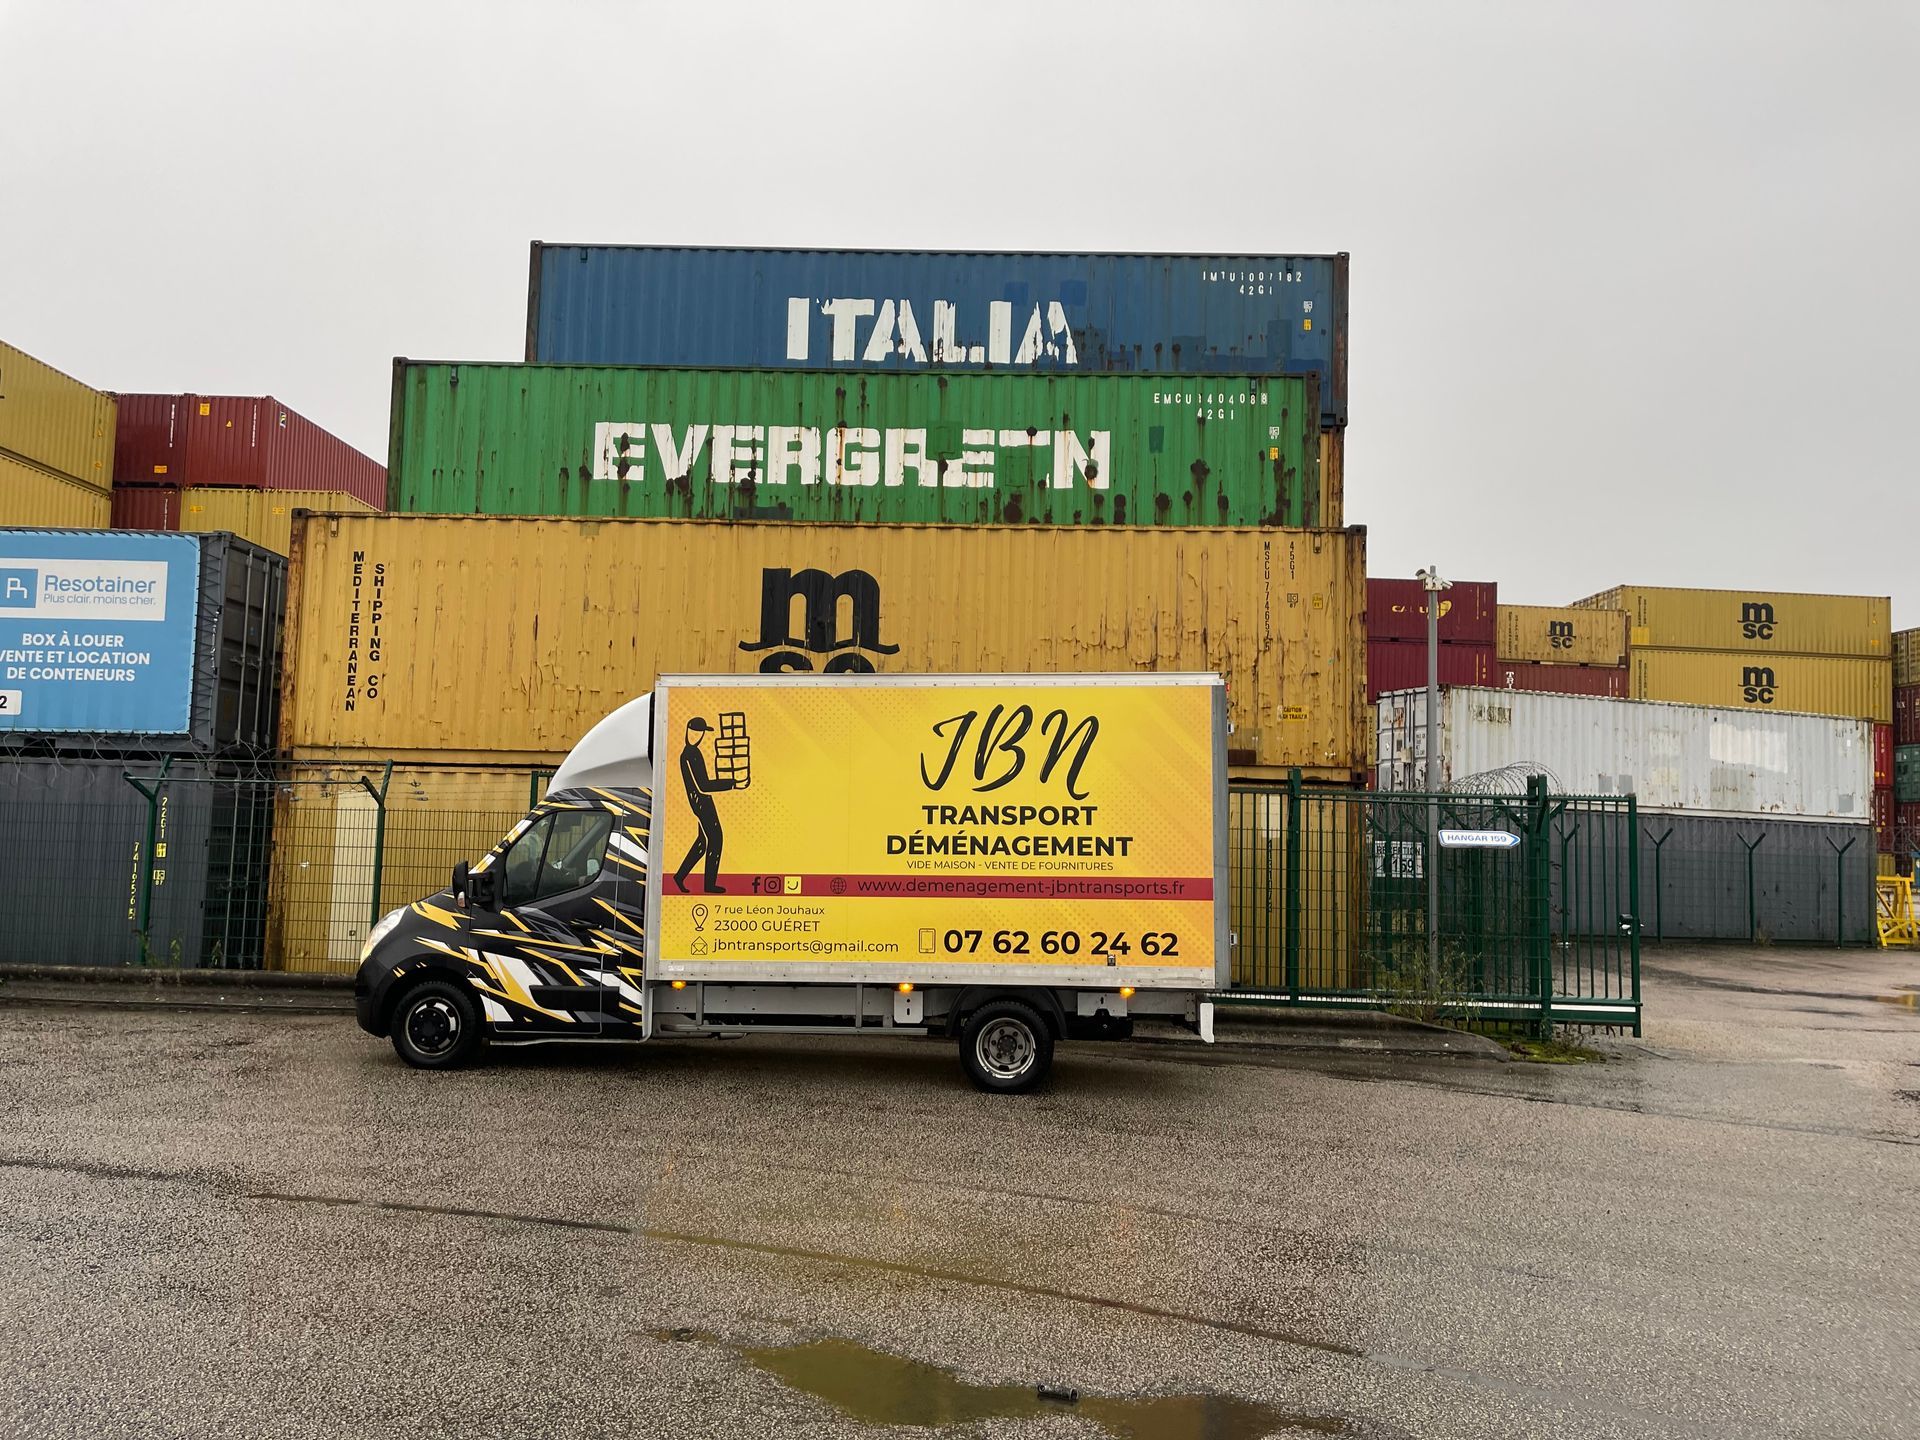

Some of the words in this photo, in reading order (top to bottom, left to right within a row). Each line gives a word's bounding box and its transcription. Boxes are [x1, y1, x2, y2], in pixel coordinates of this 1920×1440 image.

[787, 297, 1078, 364] ITALIA
[44, 575, 157, 593] Resotainer
[43, 593, 65, 604] Plus
[93, 595, 128, 605] moins
[369, 563, 385, 661] SHIPPING
[22, 633, 56, 646] BOX
[59, 631, 70, 646] À
[74, 634, 124, 647] LOUER
[345, 551, 364, 711] MEDITERRANEAN
[47, 651, 65, 663] ET
[68, 651, 150, 664] LOCATION
[6, 667, 26, 679] DE
[30, 667, 136, 682] CONTENEURS
[367, 675, 378, 699] CO
[919, 704, 1100, 800] JBN
[922, 805, 1098, 826] TRANSPORT
[886, 829, 1133, 857] DÉMÉNAGEMENT
[1447, 834, 1488, 842] HANGAR
[1490, 835, 1507, 843] 159
[906, 860, 931, 869] VIDE
[934, 860, 976, 870] MAISON
[985, 861, 1018, 870] VENTE
[1021, 861, 1036, 870] DE
[1038, 861, 1114, 871] FOURNITURES
[857, 877, 1185, 897] www.demenagement-jbntransports.fr
[714, 905, 722, 914] 7
[724, 906, 743, 915] rue
[746, 904, 774, 915] Léon
[776, 904, 825, 915] Jouhaux
[714, 920, 758, 932] 23000
[761, 918, 820, 932] GUÉRET
[712, 938, 899, 954] jbntransports@gmail.com
[943, 930, 982, 953] 07
[992, 930, 1030, 954] 62
[1040, 931, 1080, 955] 60
[1090, 931, 1131, 956] 24
[1140, 932, 1179, 956] 62
